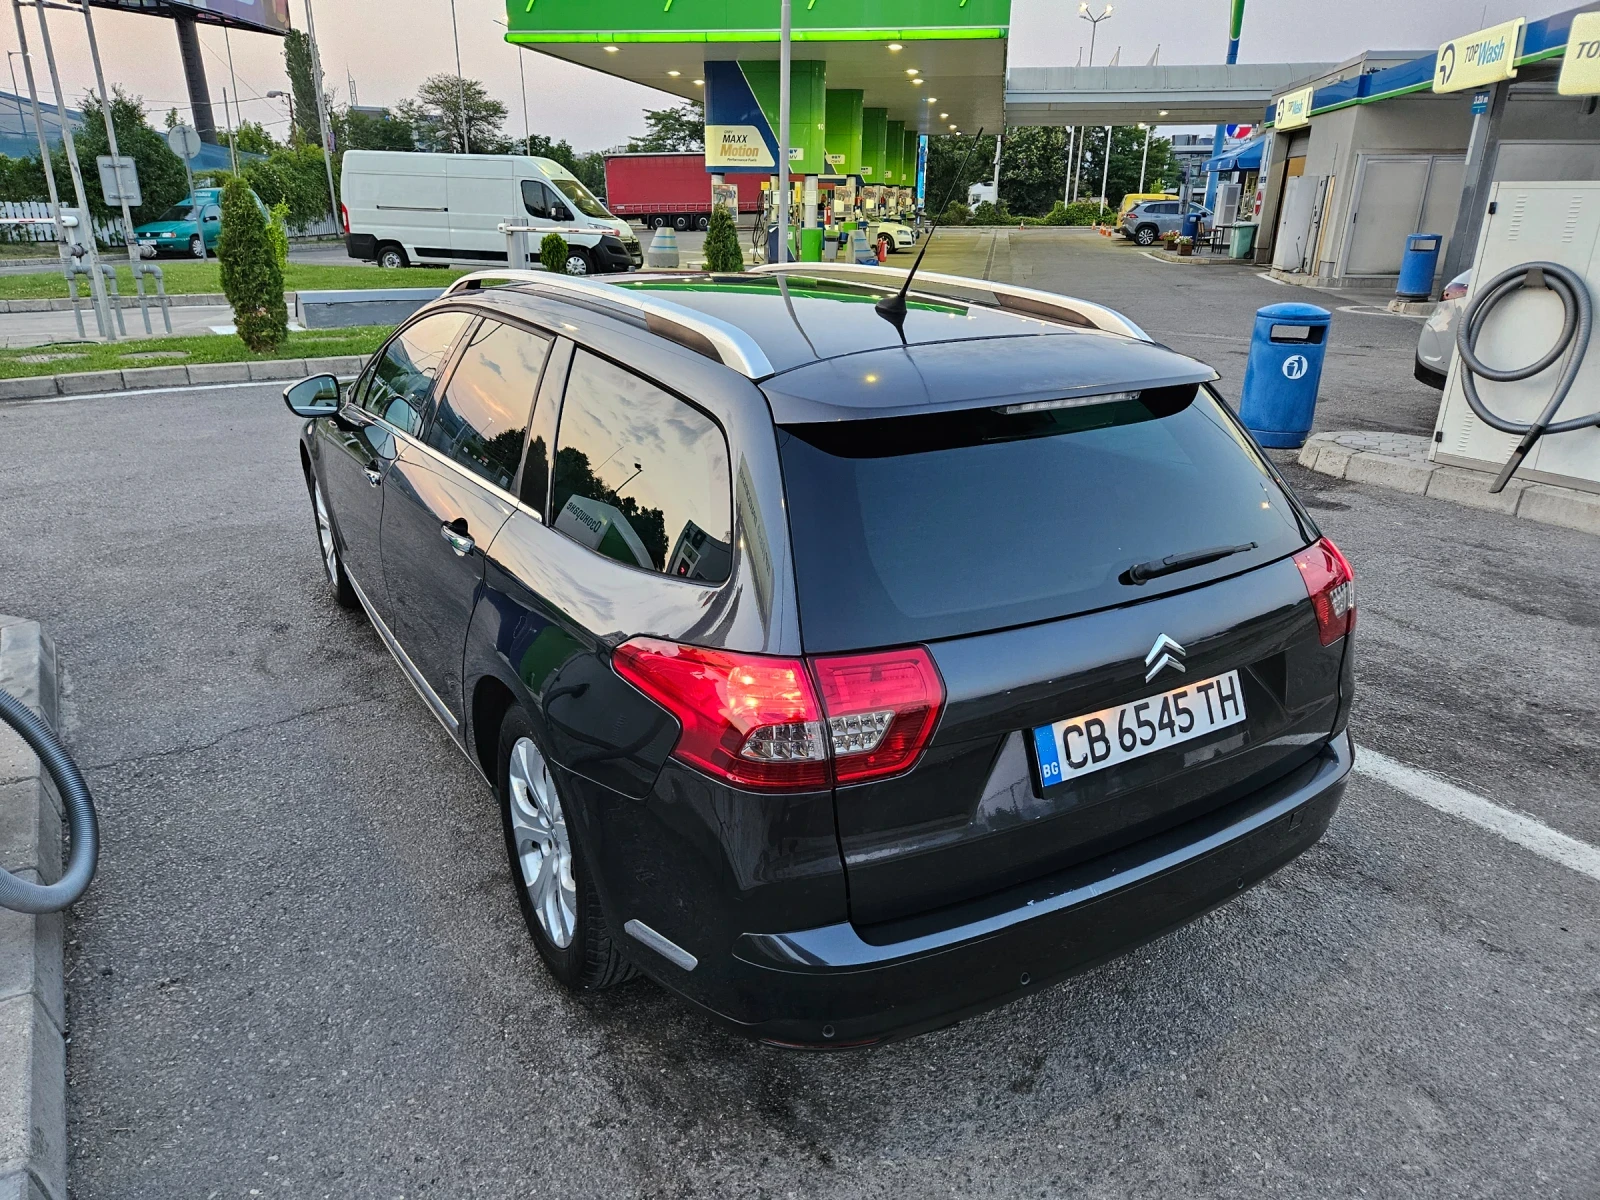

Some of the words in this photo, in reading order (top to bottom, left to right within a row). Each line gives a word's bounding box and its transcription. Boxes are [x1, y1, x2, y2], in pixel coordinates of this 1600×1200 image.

[722, 134, 748, 144] MAXX
[720, 144, 759, 157] Motion
[1118, 690, 1195, 753] 6545
[1042, 761, 1060, 779] BG
